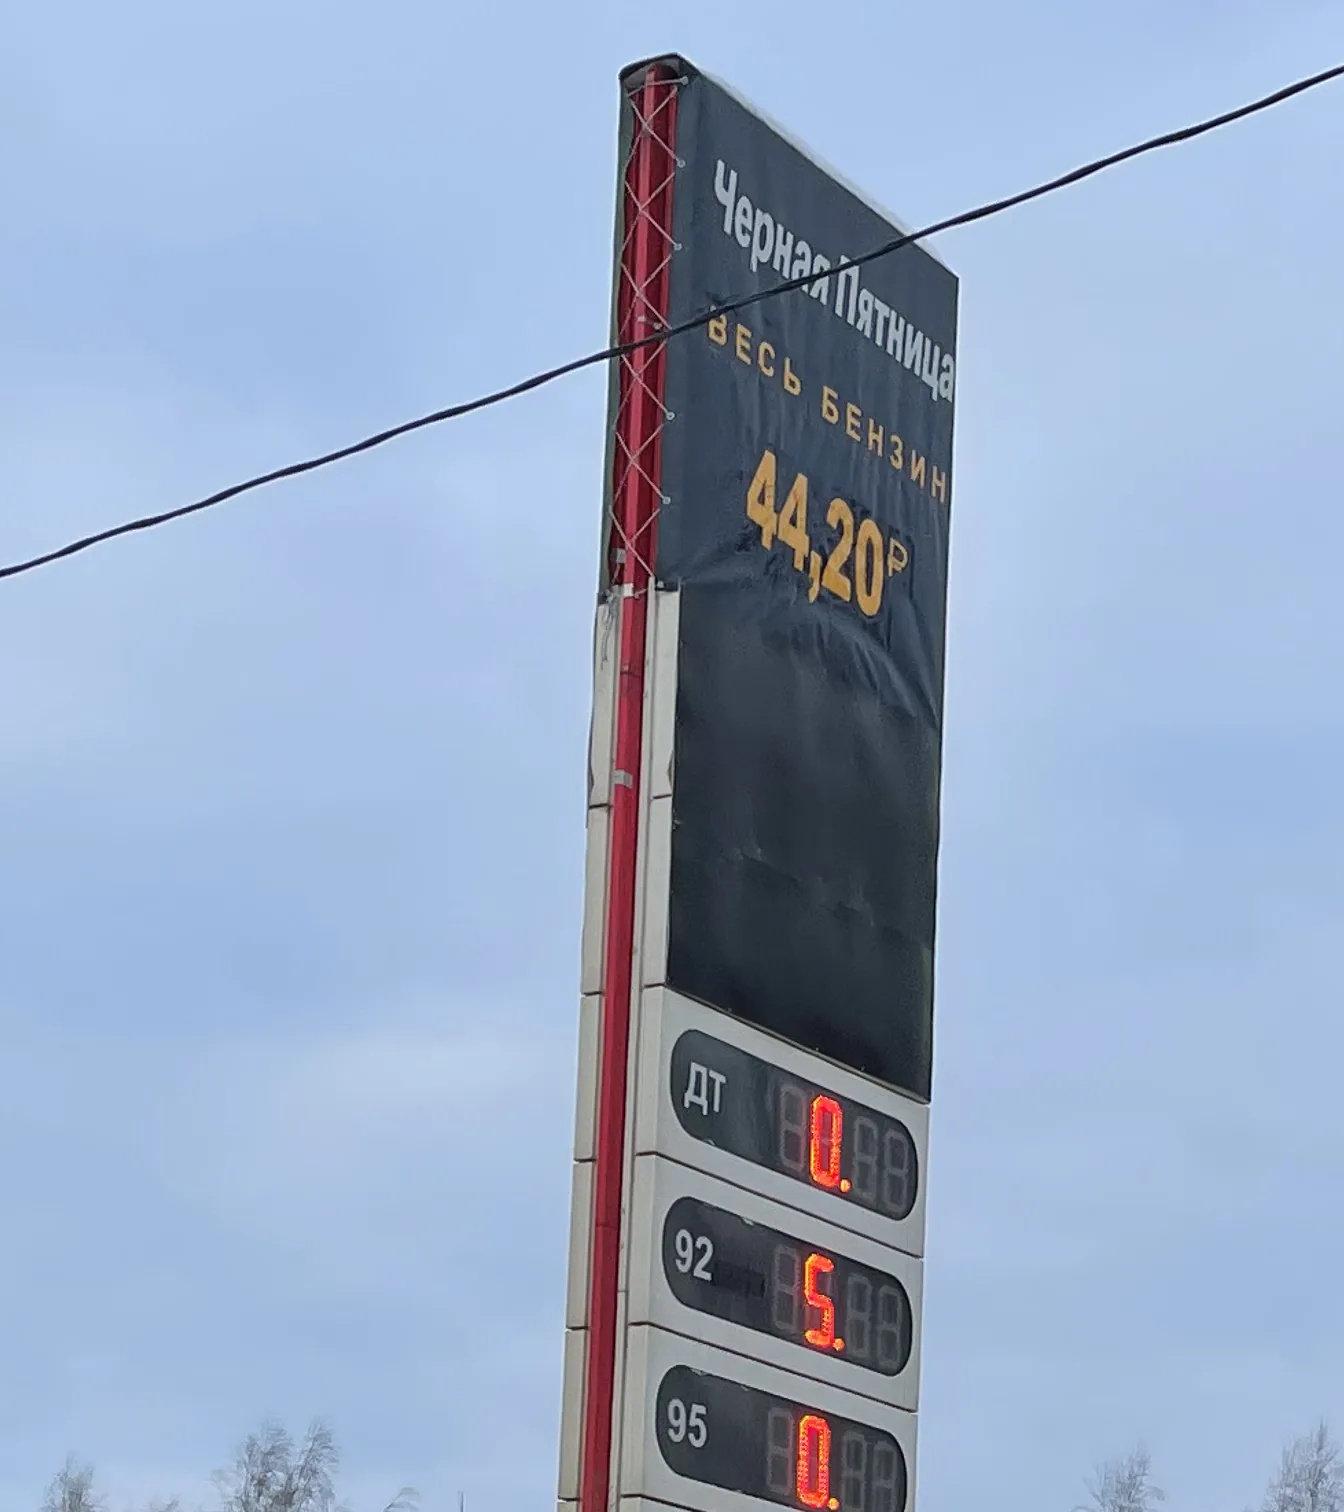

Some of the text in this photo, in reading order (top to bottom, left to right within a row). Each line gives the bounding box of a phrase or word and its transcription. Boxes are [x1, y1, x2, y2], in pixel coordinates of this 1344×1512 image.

[714, 159, 954, 402] Черная Пятница
[708, 305, 946, 503] ВЕСЬ БЕНЗИН
[684, 1062, 727, 1115] ДТ
[674, 1230, 714, 1281] 92
[667, 1399, 707, 1448] 95
